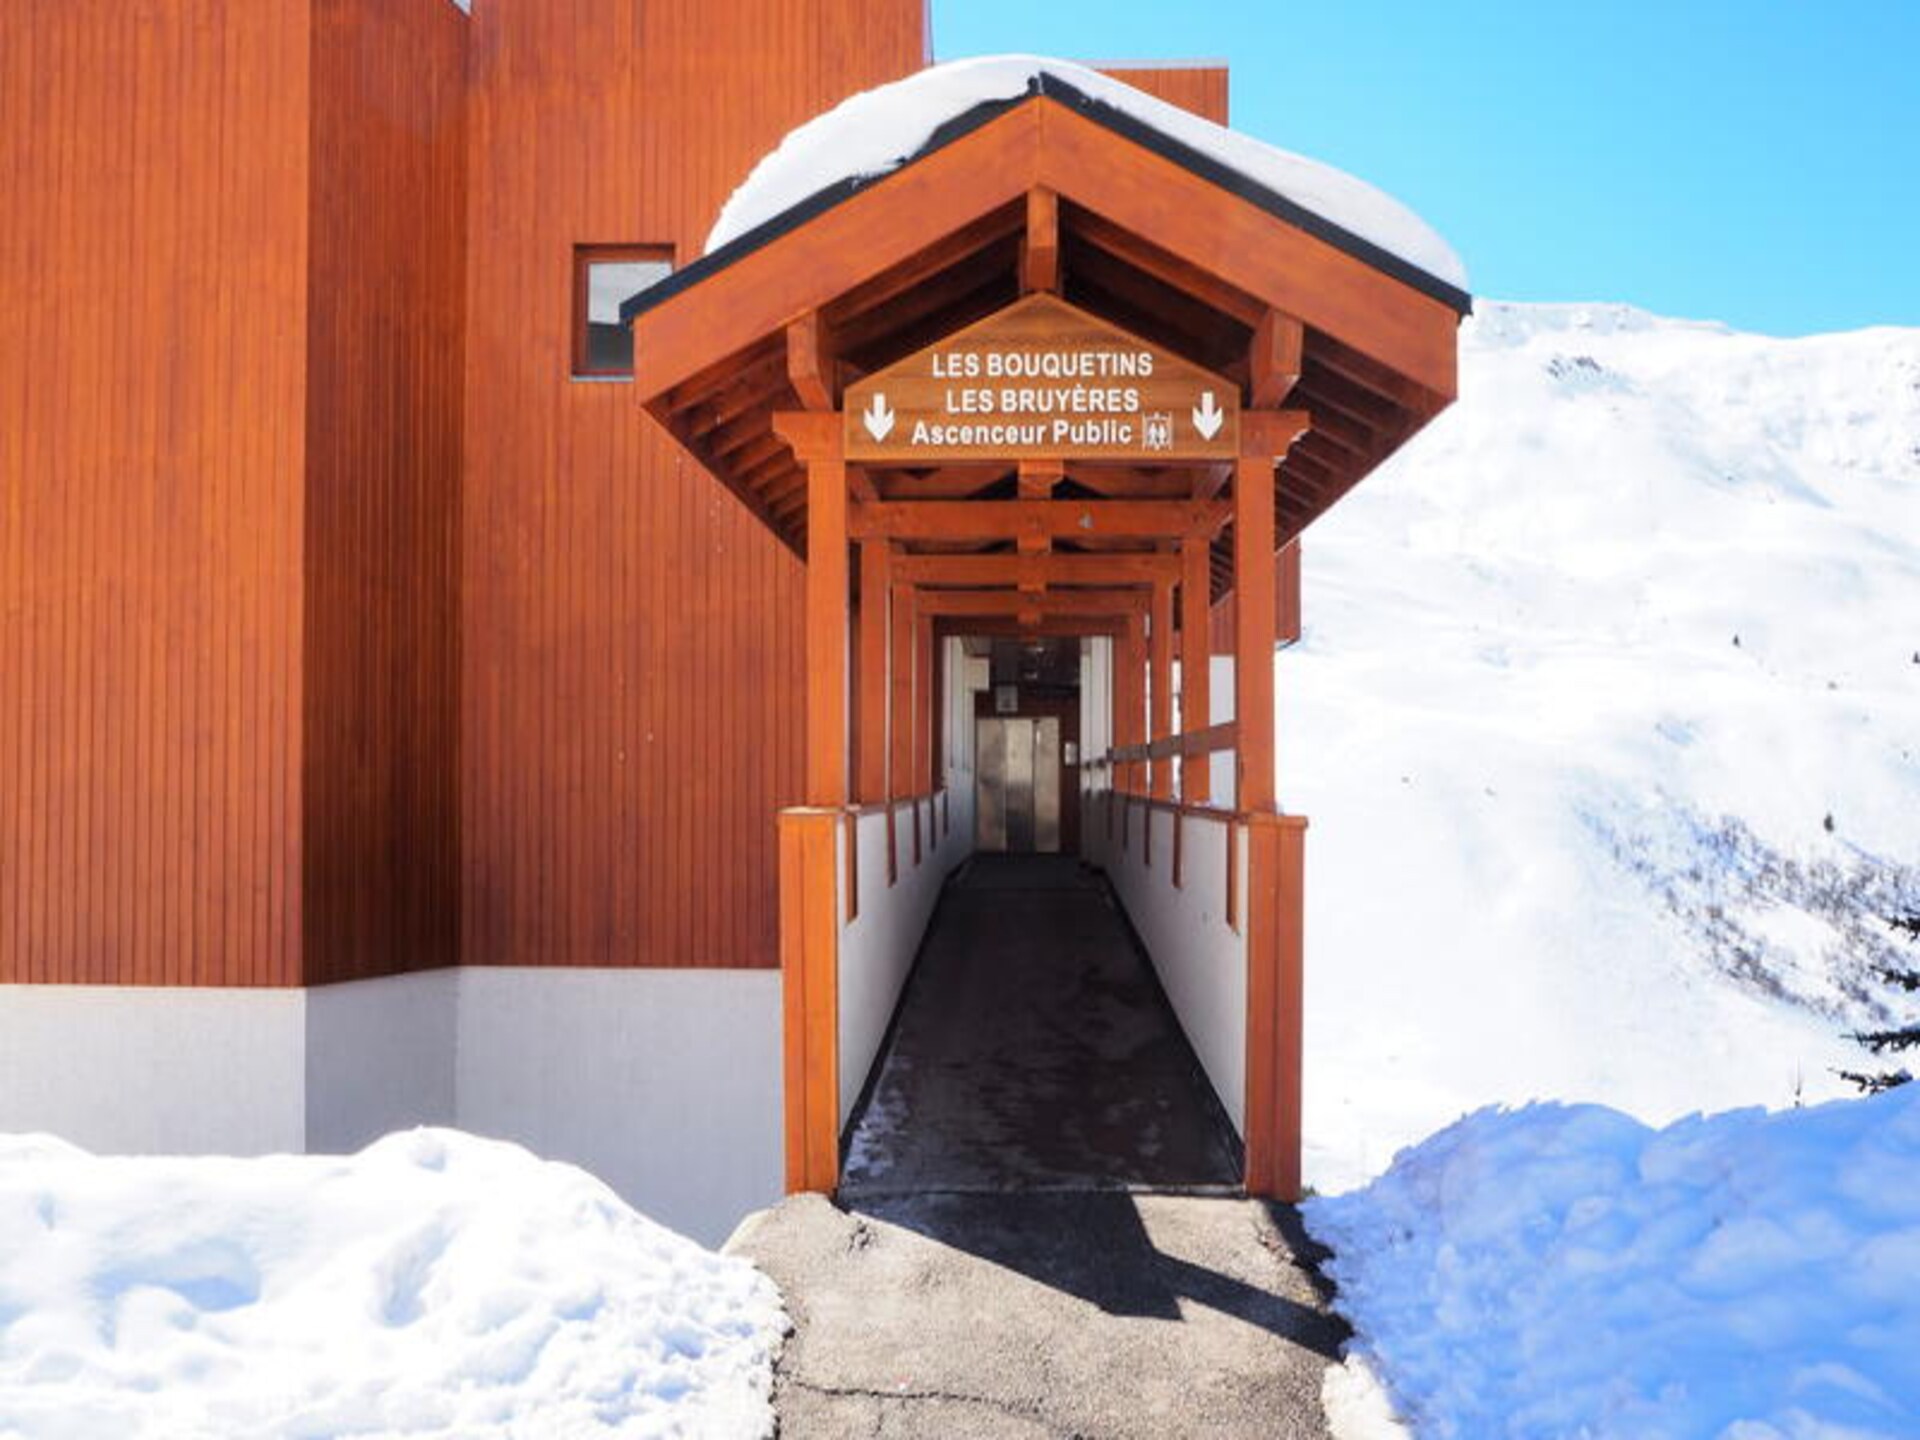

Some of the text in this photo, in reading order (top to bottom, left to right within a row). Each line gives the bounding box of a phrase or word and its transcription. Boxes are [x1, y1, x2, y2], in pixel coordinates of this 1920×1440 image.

[932, 352, 1154, 377] LES BOUQUETINS
[946, 384, 1140, 413] LES BRUYÈRES
[912, 420, 1132, 445] Ascenceur Public
